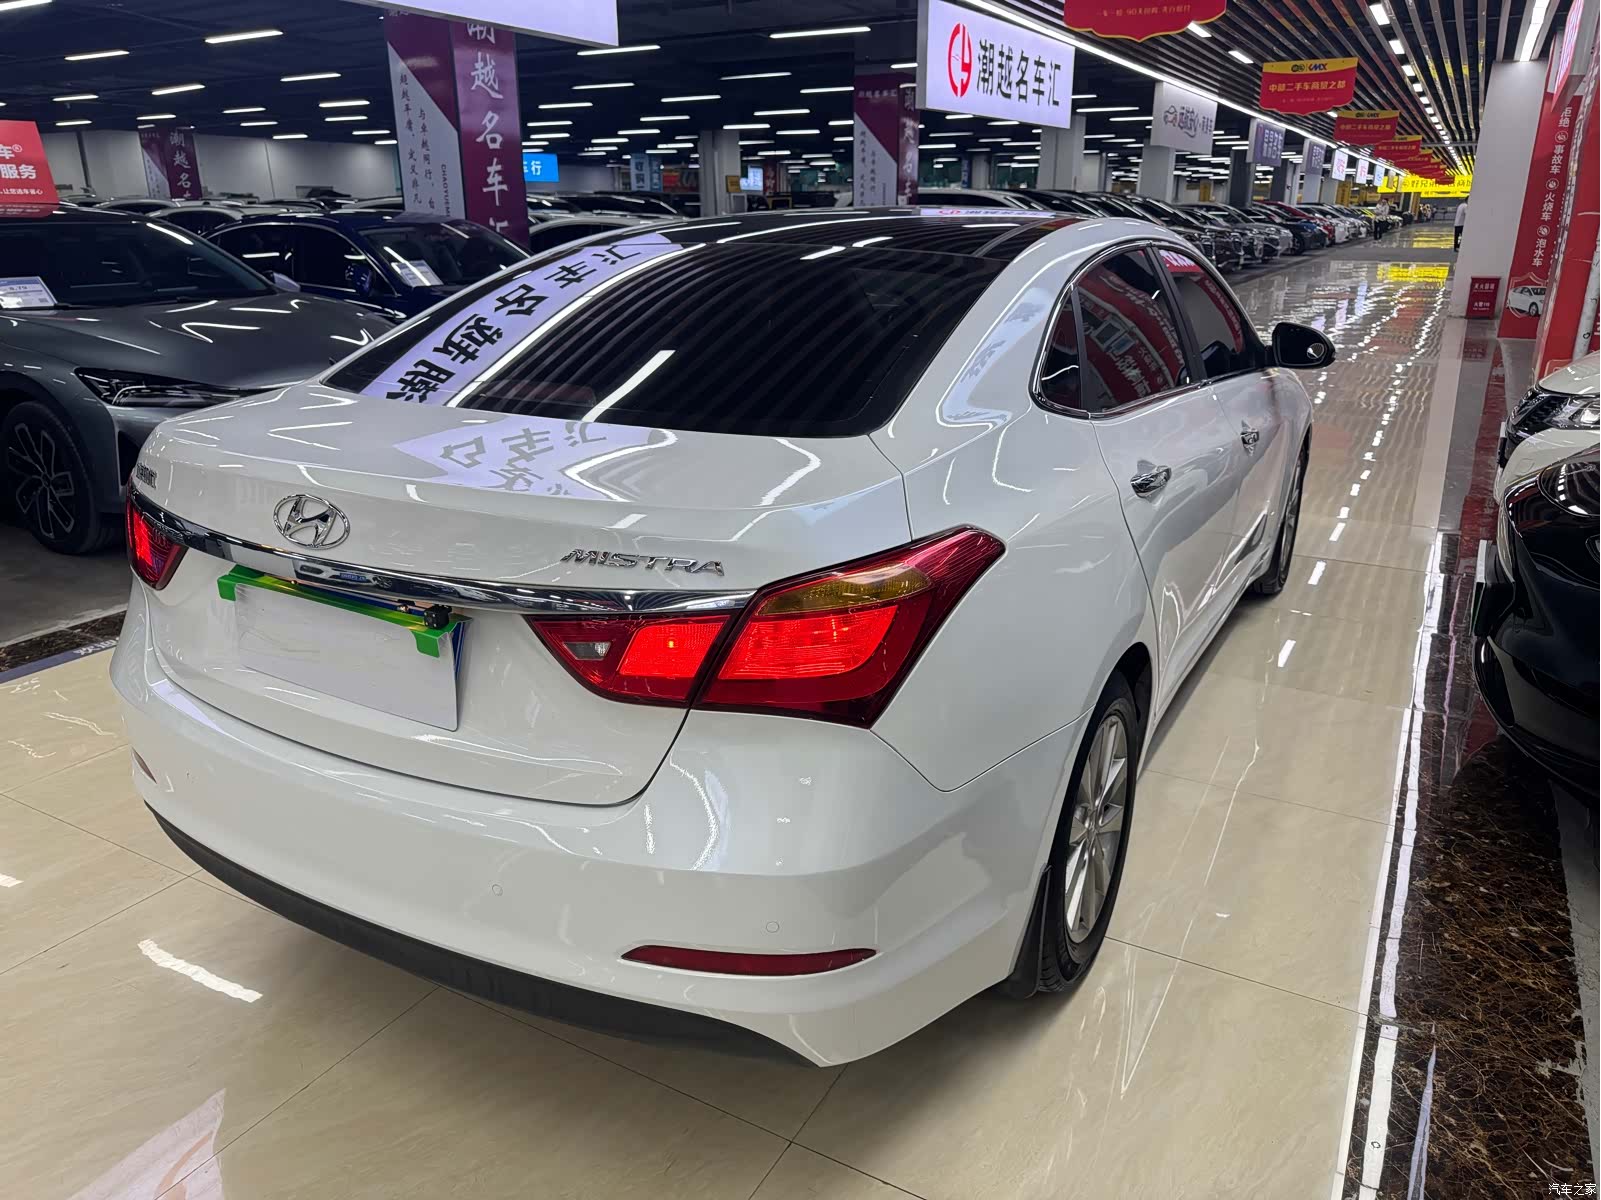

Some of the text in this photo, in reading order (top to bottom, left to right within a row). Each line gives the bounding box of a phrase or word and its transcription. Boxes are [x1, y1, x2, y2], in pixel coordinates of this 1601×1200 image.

[976, 39, 1061, 107] 潮越名车汇
[1549, 144, 1565, 175] 事故车
[1540, 192, 1556, 221] 火烧车
[1531, 238, 1547, 267] 泡水车
[560, 548, 725, 577] MISTRA
